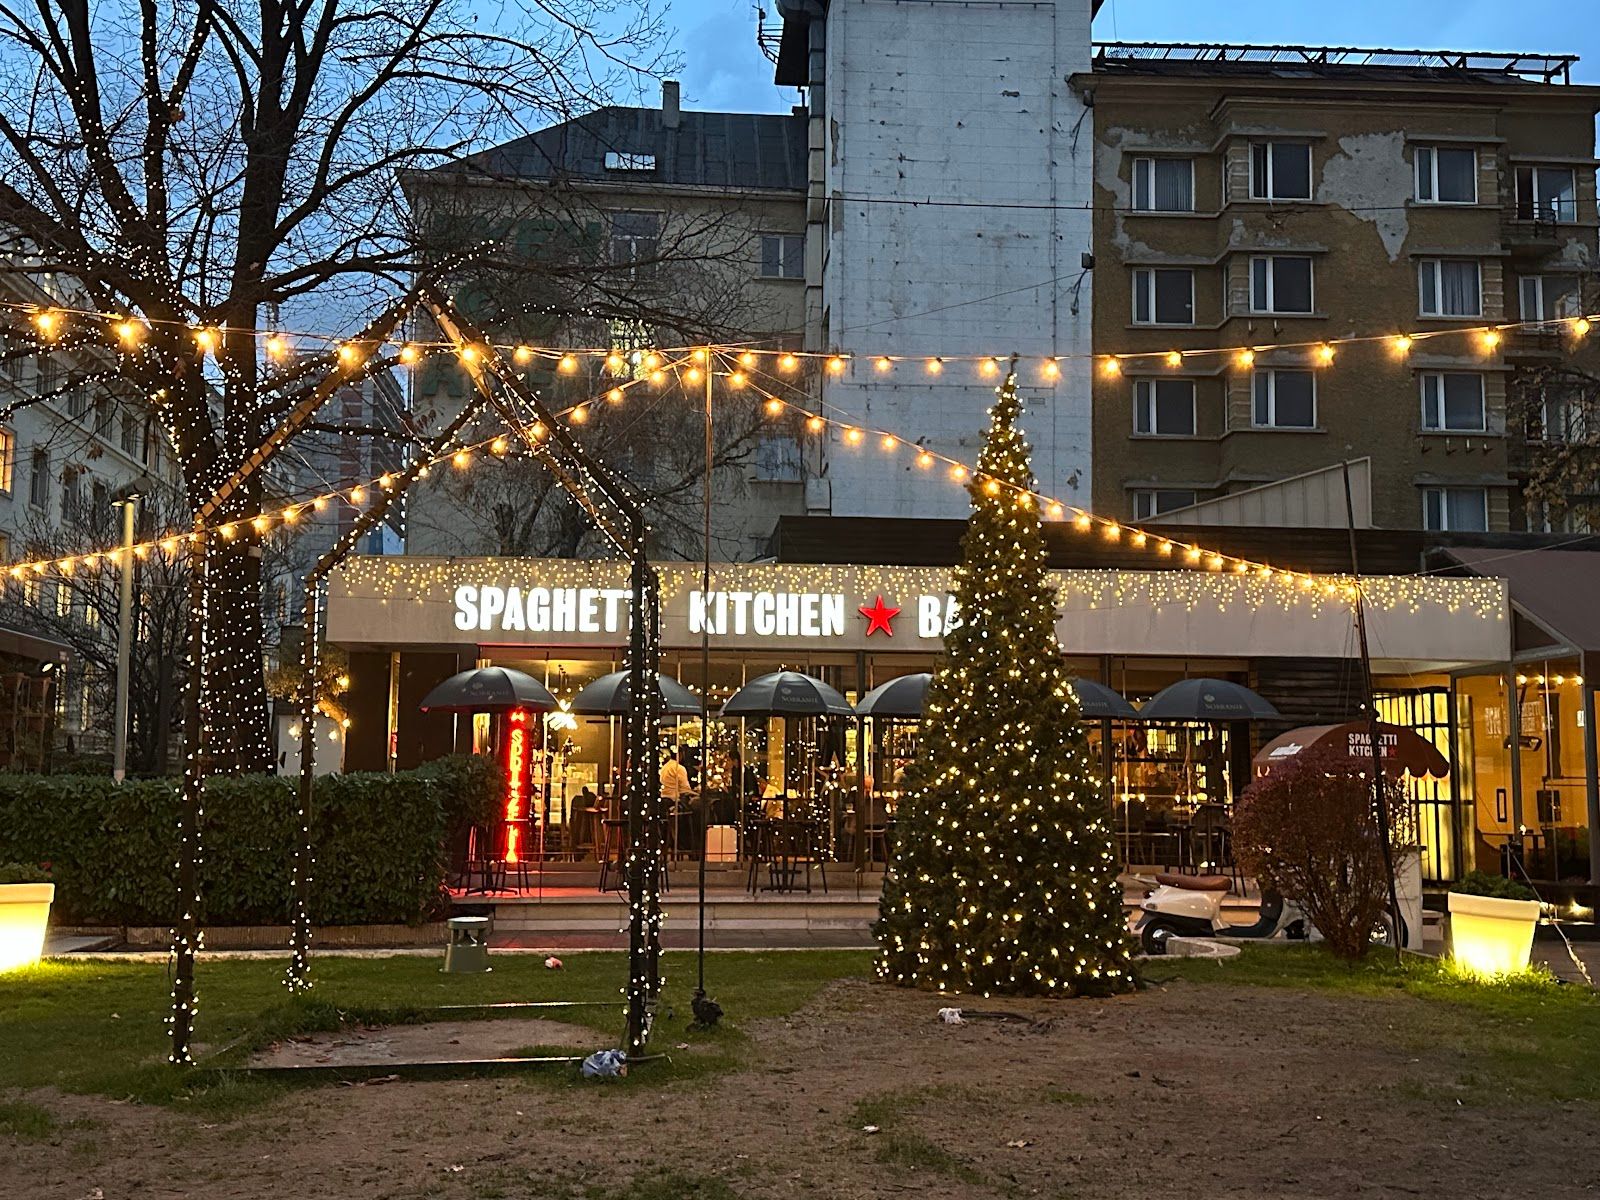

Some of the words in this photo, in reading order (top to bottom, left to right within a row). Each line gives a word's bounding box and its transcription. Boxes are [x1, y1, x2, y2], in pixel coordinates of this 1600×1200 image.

[455, 585, 649, 632] SPAGHET
[689, 590, 845, 636] KITCHEN
[918, 595, 964, 638] BA
[1348, 733, 1398, 746] SPAGETTI
[1348, 745, 1388, 757] KITCN
